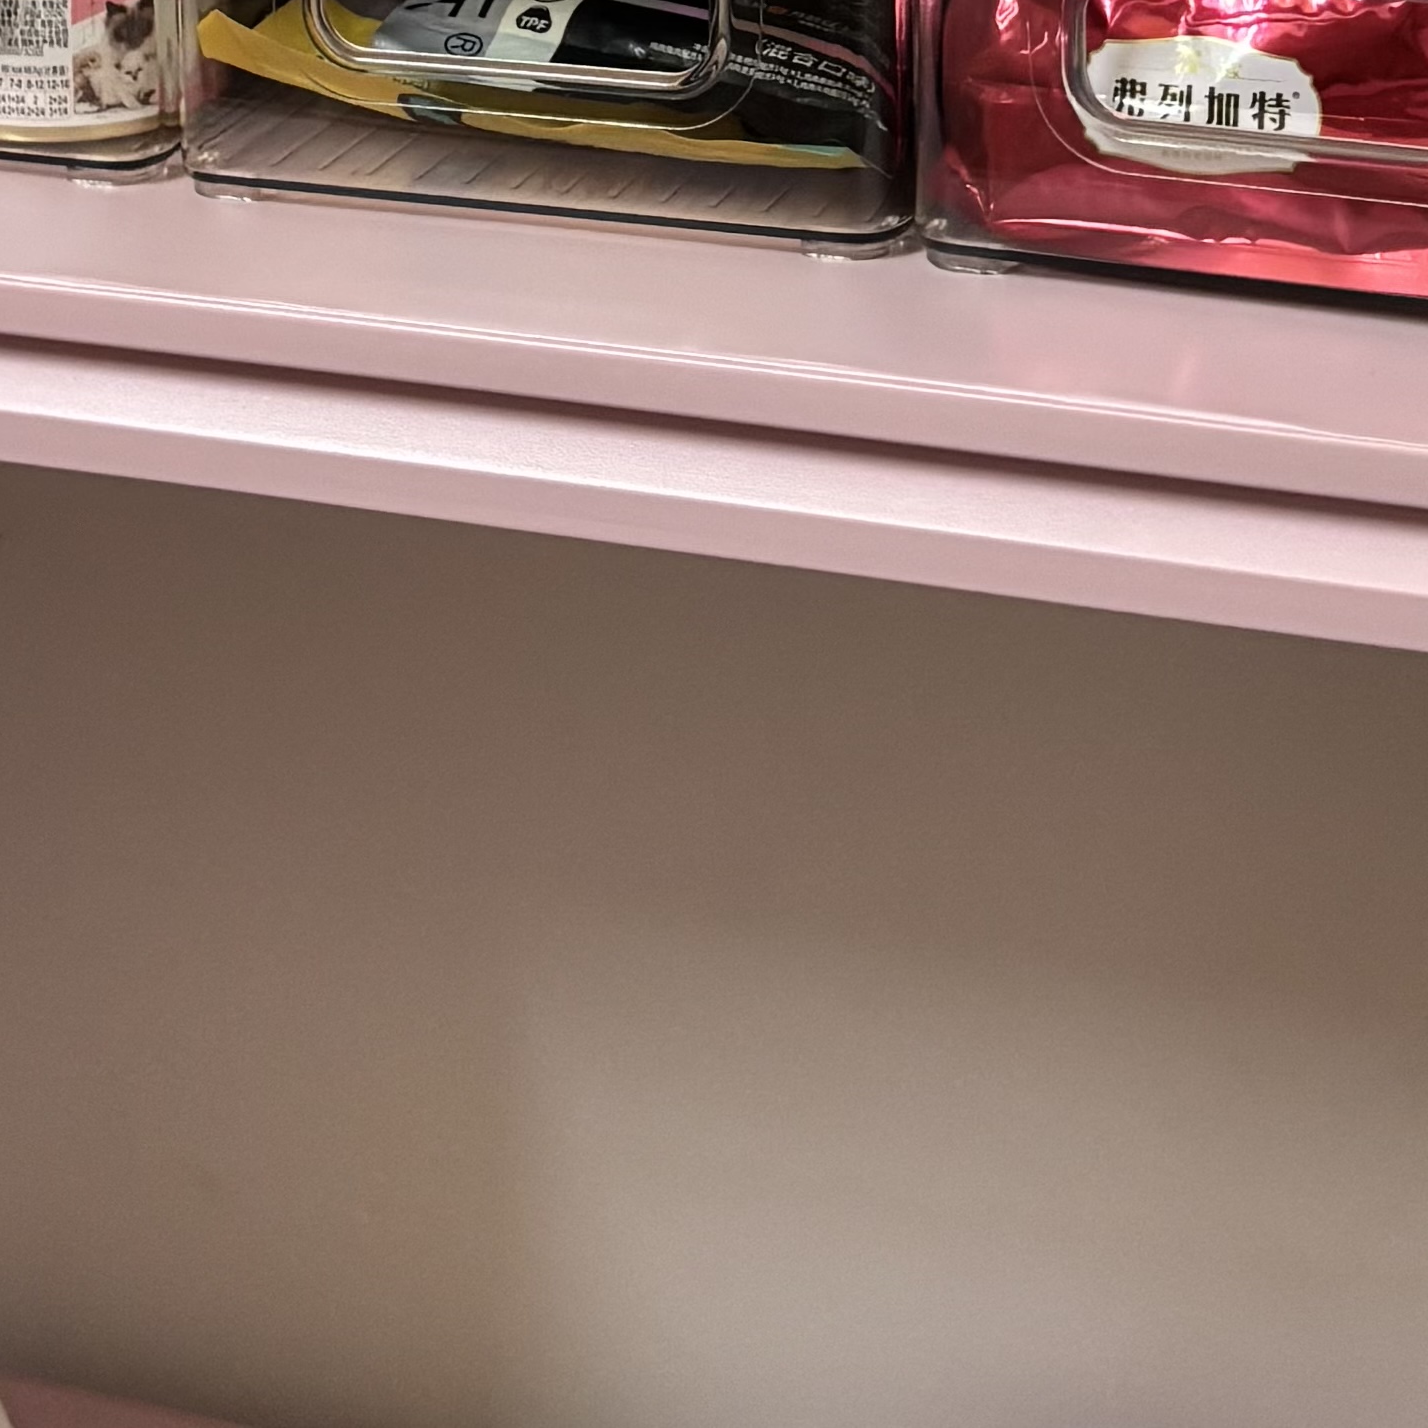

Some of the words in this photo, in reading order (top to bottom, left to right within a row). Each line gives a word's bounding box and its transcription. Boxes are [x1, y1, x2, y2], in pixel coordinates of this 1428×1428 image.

[519, 15, 550, 31] TPF
[1112, 76, 1291, 132] 弗列加特
